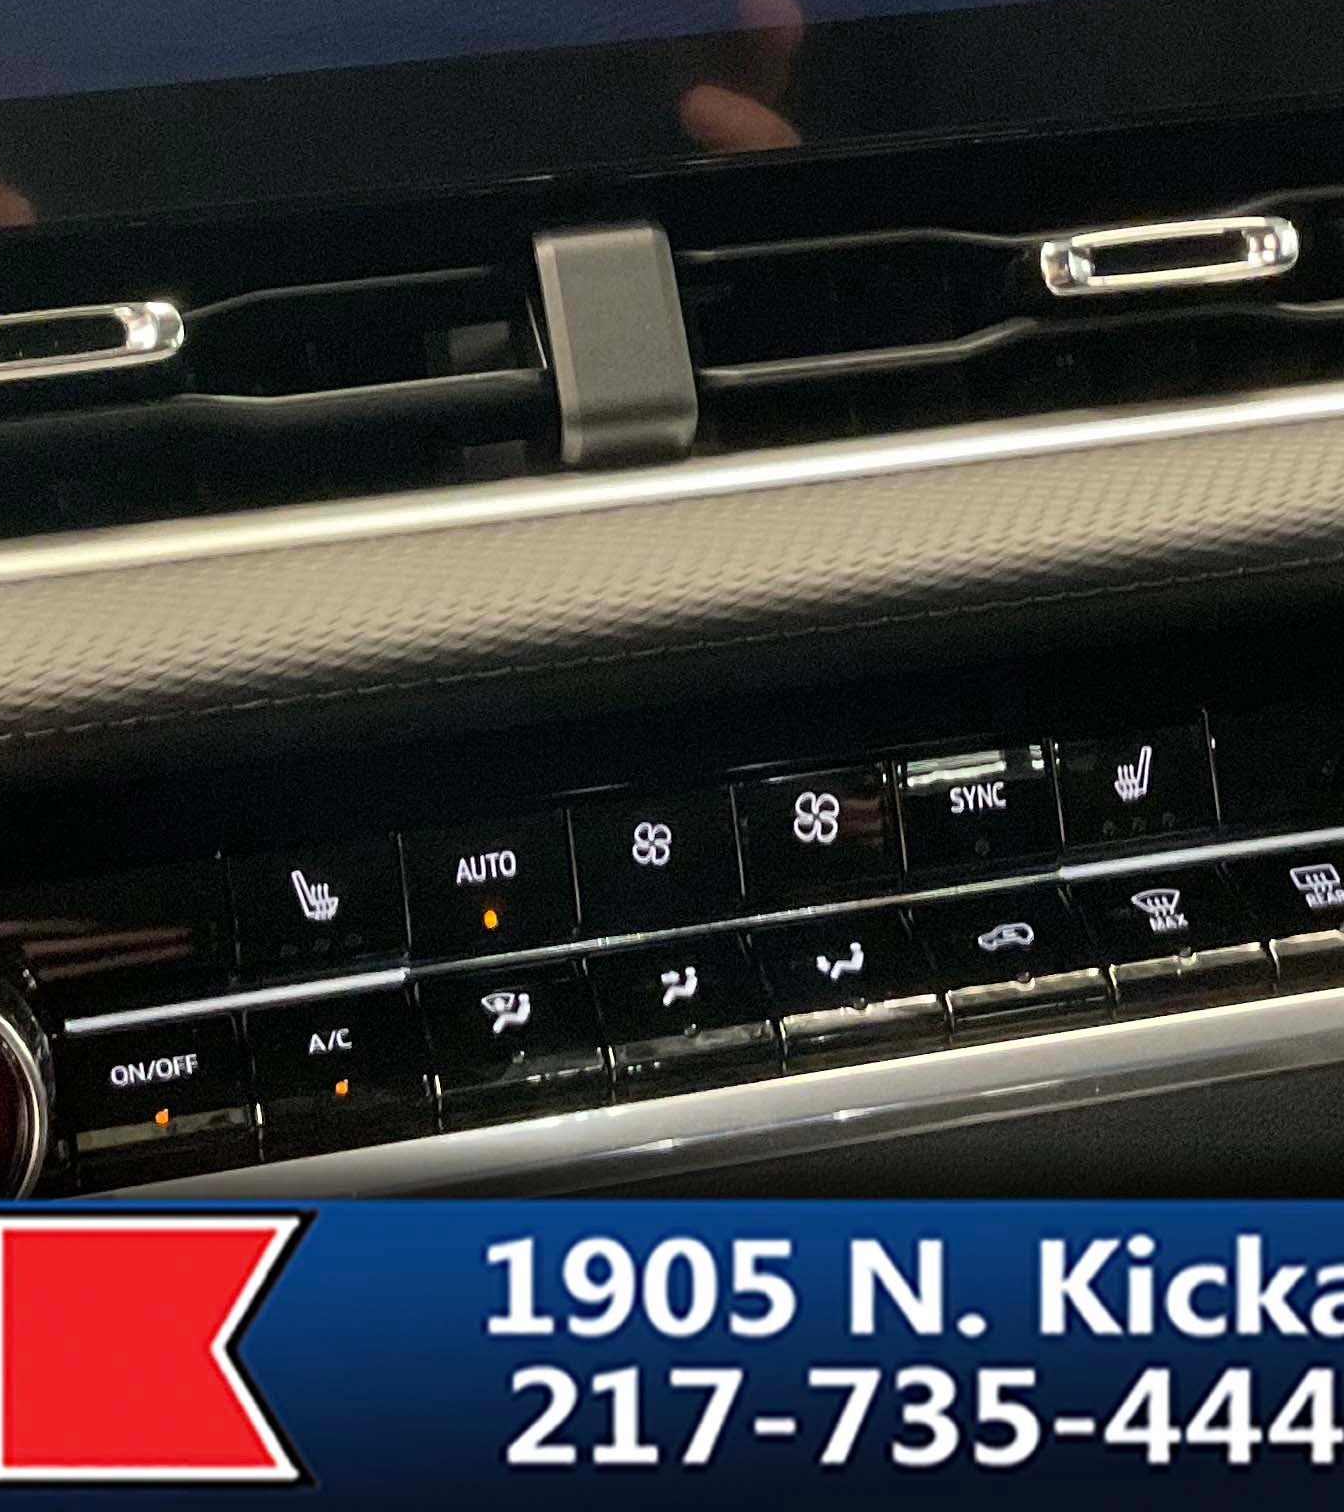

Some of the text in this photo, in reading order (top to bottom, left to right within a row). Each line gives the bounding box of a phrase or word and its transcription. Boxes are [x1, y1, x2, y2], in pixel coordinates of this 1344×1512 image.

[949, 781, 1007, 814] SYNC
[456, 849, 518, 884] AUTO
[308, 1026, 354, 1055] A/C
[109, 1053, 199, 1087] ON/OFF
